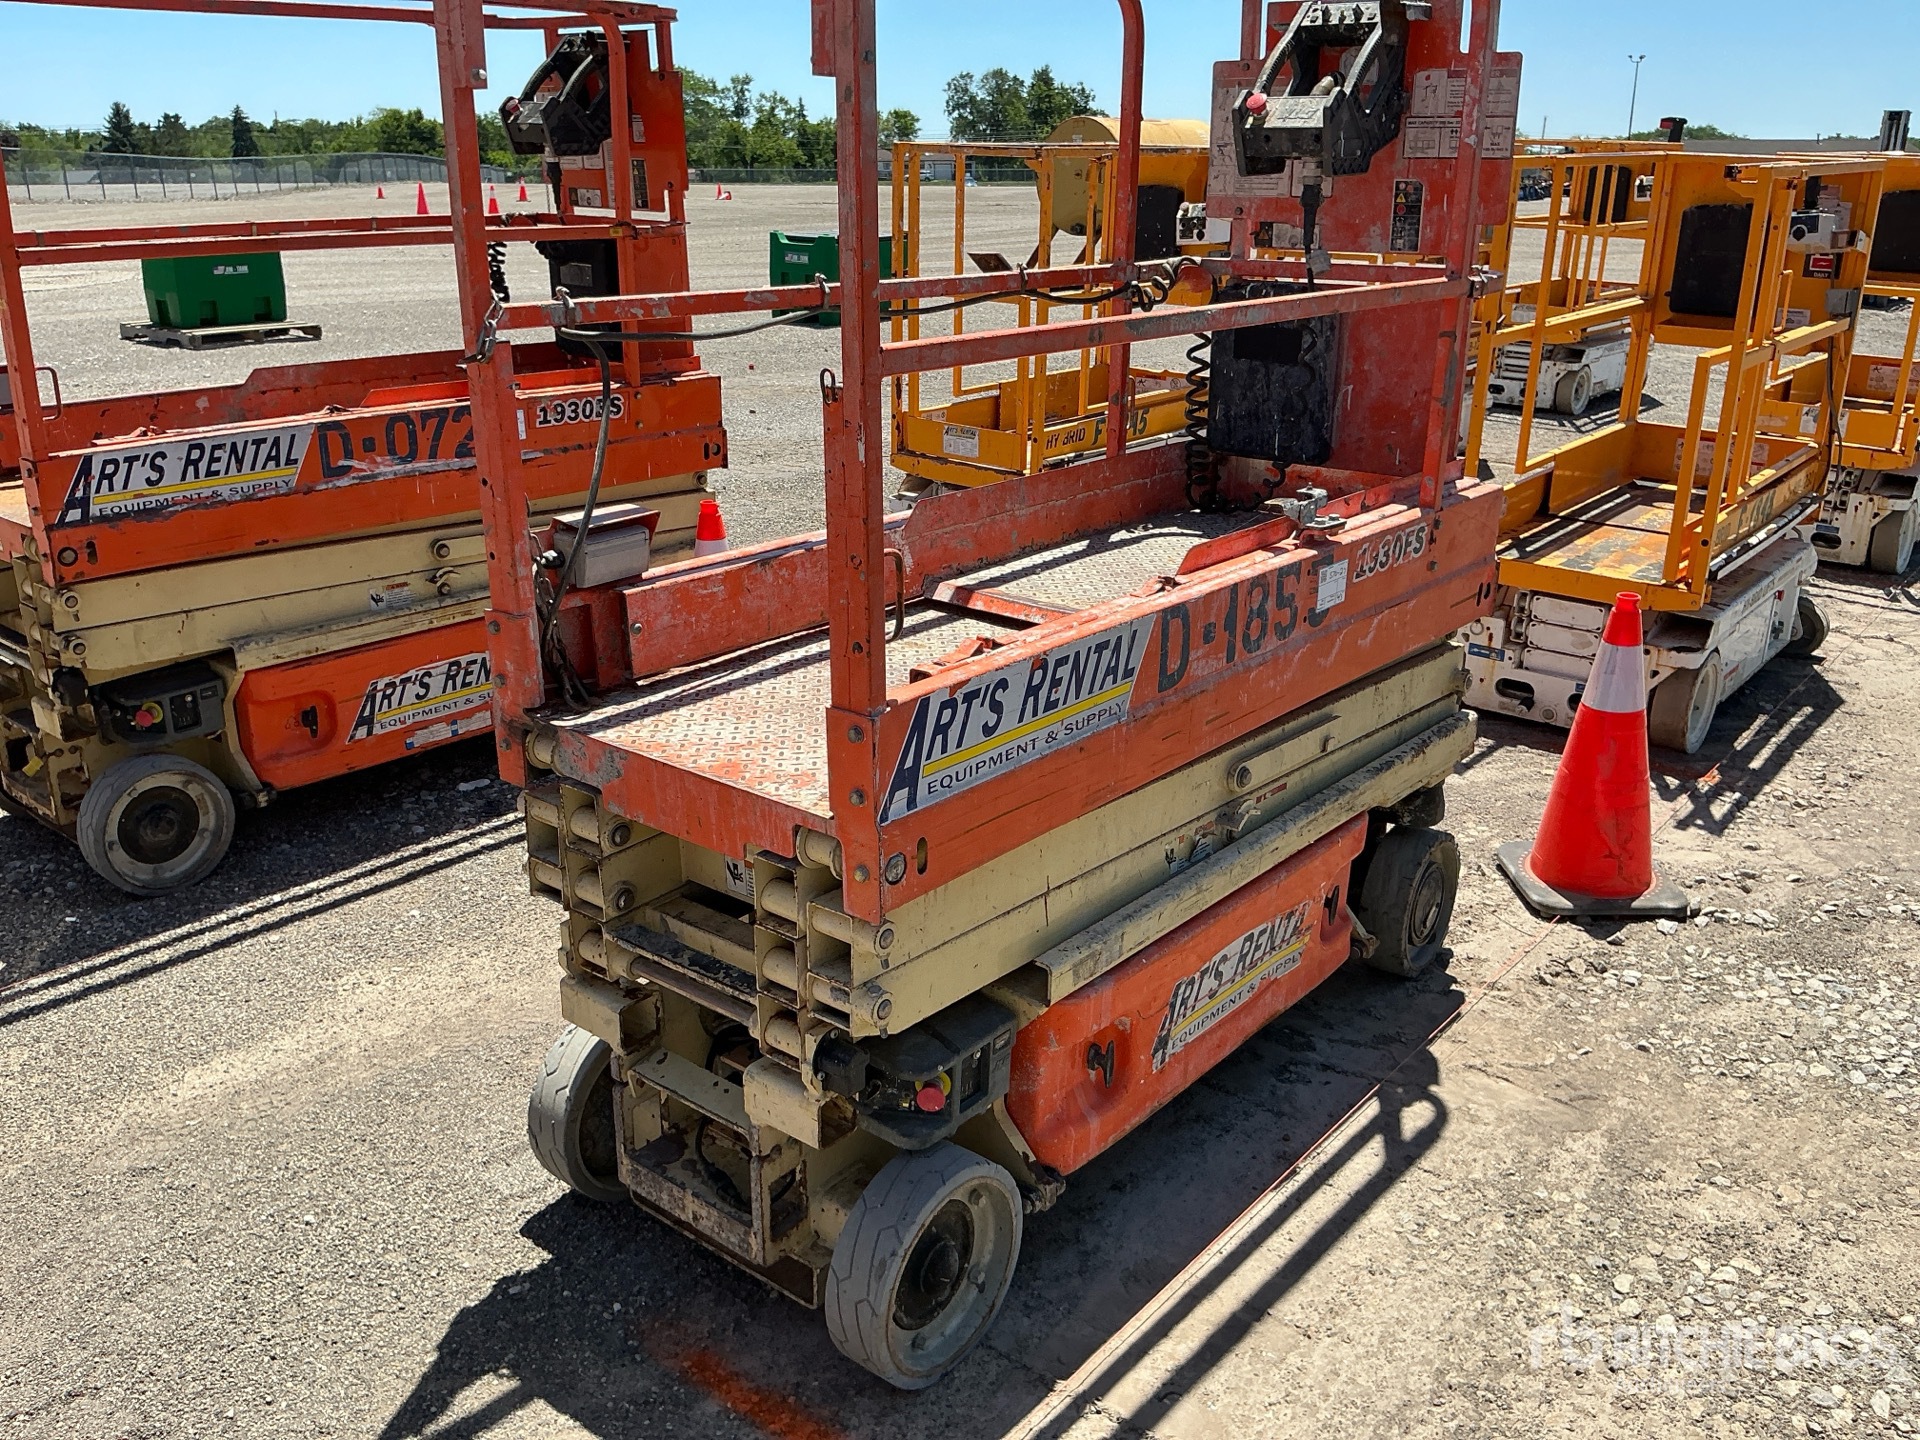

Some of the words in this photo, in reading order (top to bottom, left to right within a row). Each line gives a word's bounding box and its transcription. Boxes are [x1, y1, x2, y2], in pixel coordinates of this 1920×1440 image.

[54, 451, 168, 527] ART'S
[180, 432, 300, 482] RENTAL
[209, 486, 223, 498] &
[228, 478, 293, 497] SUPPLY
[347, 670, 433, 743] ART'S
[442, 656, 492, 694] REN
[380, 701, 460, 730] EQUIPMENT
[463, 697, 475, 706] &
[878, 677, 1010, 825] ART'S
[1017, 629, 1139, 725] RENTAL
[927, 736, 1040, 796] EQUIPMENT
[1044, 729, 1058, 745] &
[1064, 700, 1126, 737] SUPPLY
[1171, 991, 1247, 1050] EQUIPMENT
[1247, 982, 1257, 994] &
